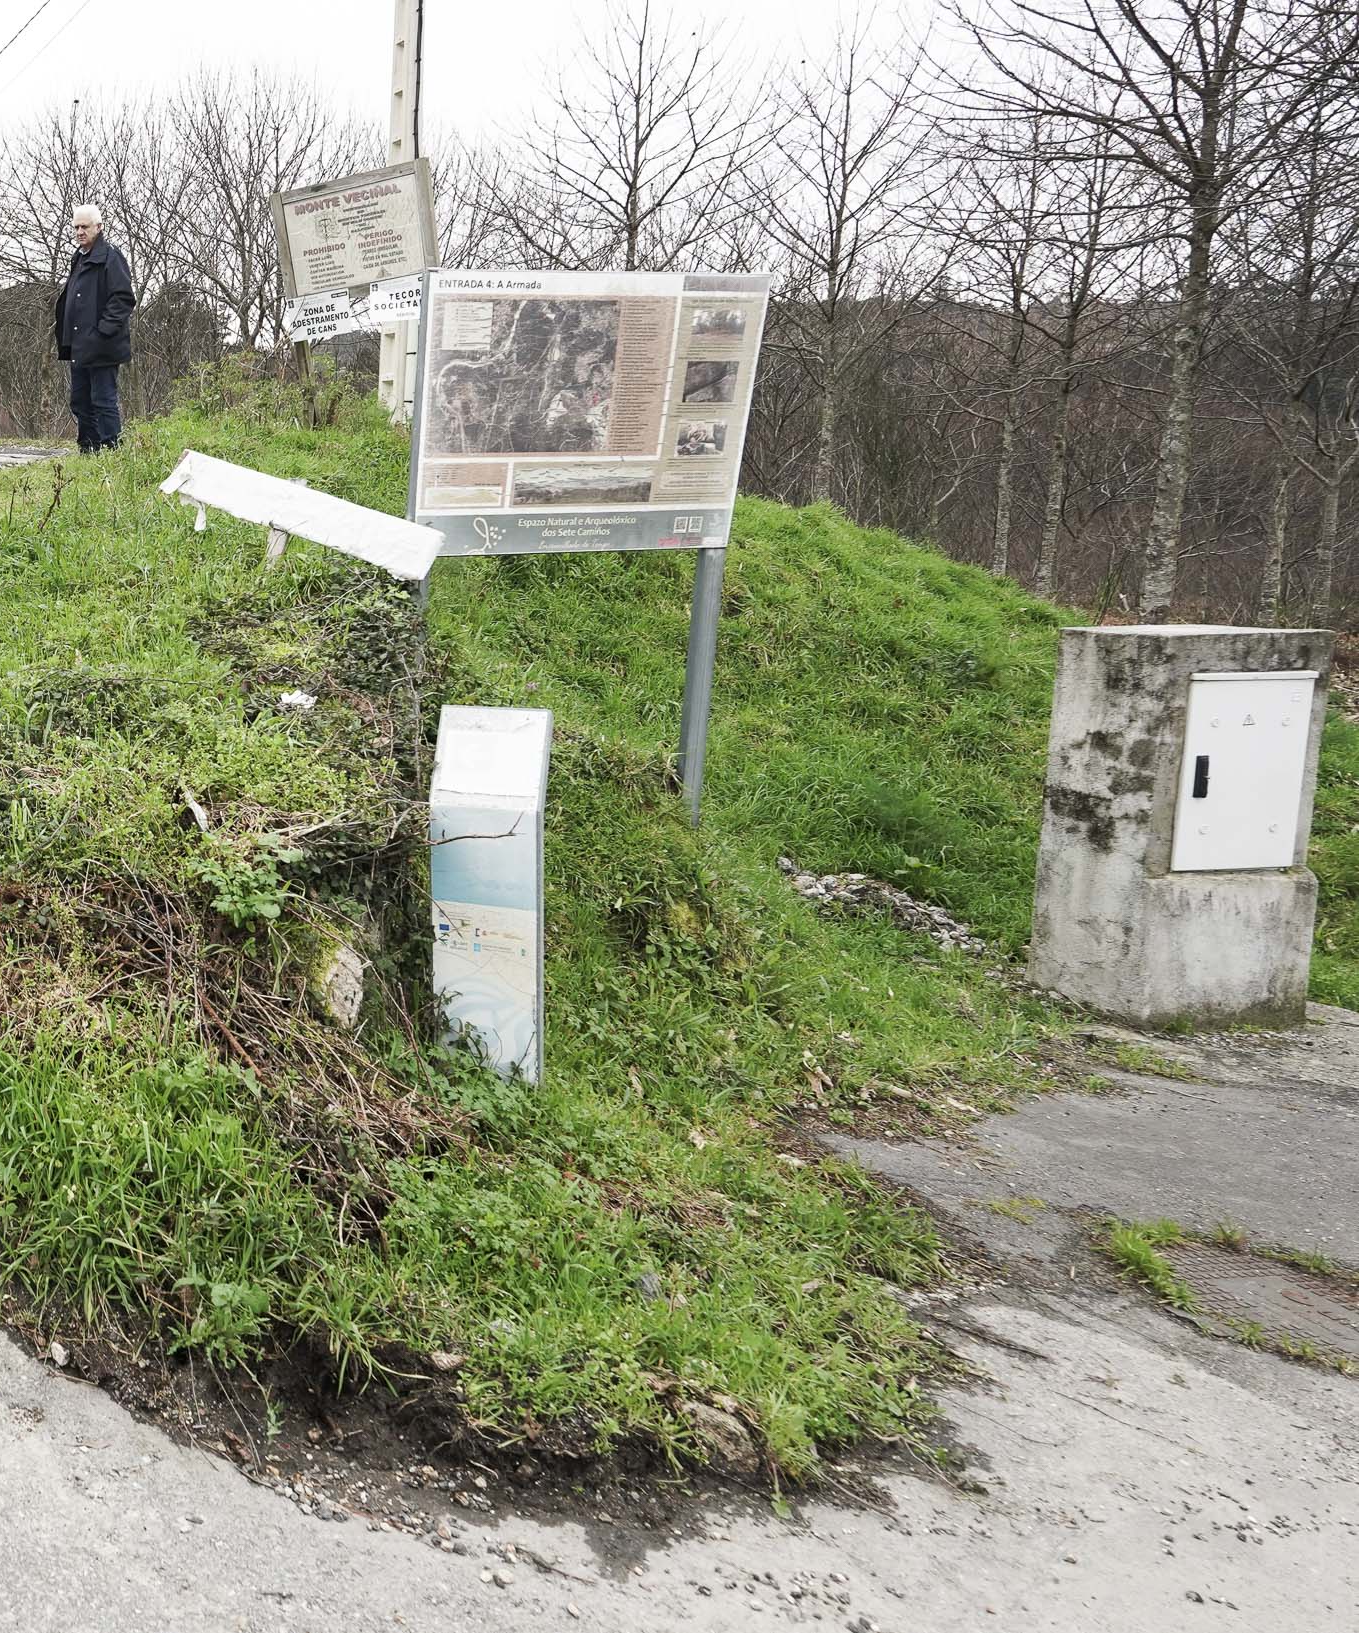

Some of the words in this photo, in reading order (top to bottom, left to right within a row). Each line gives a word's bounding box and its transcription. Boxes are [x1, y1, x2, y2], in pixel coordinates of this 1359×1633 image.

[294, 197, 340, 216] MONTE
[358, 234, 402, 249] INDEFINIDO
[303, 242, 346, 257] PROHIBIDO
[439, 279, 483, 289] ENTRADA
[486, 280, 495, 289] 4:
[497, 280, 504, 289] A
[506, 280, 542, 290] Armada
[389, 288, 421, 301] TECOR
[303, 306, 324, 317] ZONA
[326, 303, 336, 313] DE
[374, 299, 422, 311] SOCIETA
[292, 311, 349, 329] ADESTRAMENTO
[307, 327, 316, 336] DE
[318, 324, 337, 334] CANS
[518, 518, 546, 528] Espazo
[547, 517, 577, 526] Natural
[584, 516, 636, 527] Arqueolóxico
[542, 528, 556, 537] dos
[558, 528, 576, 537] Sete
[577, 527, 611, 536] Camiños
